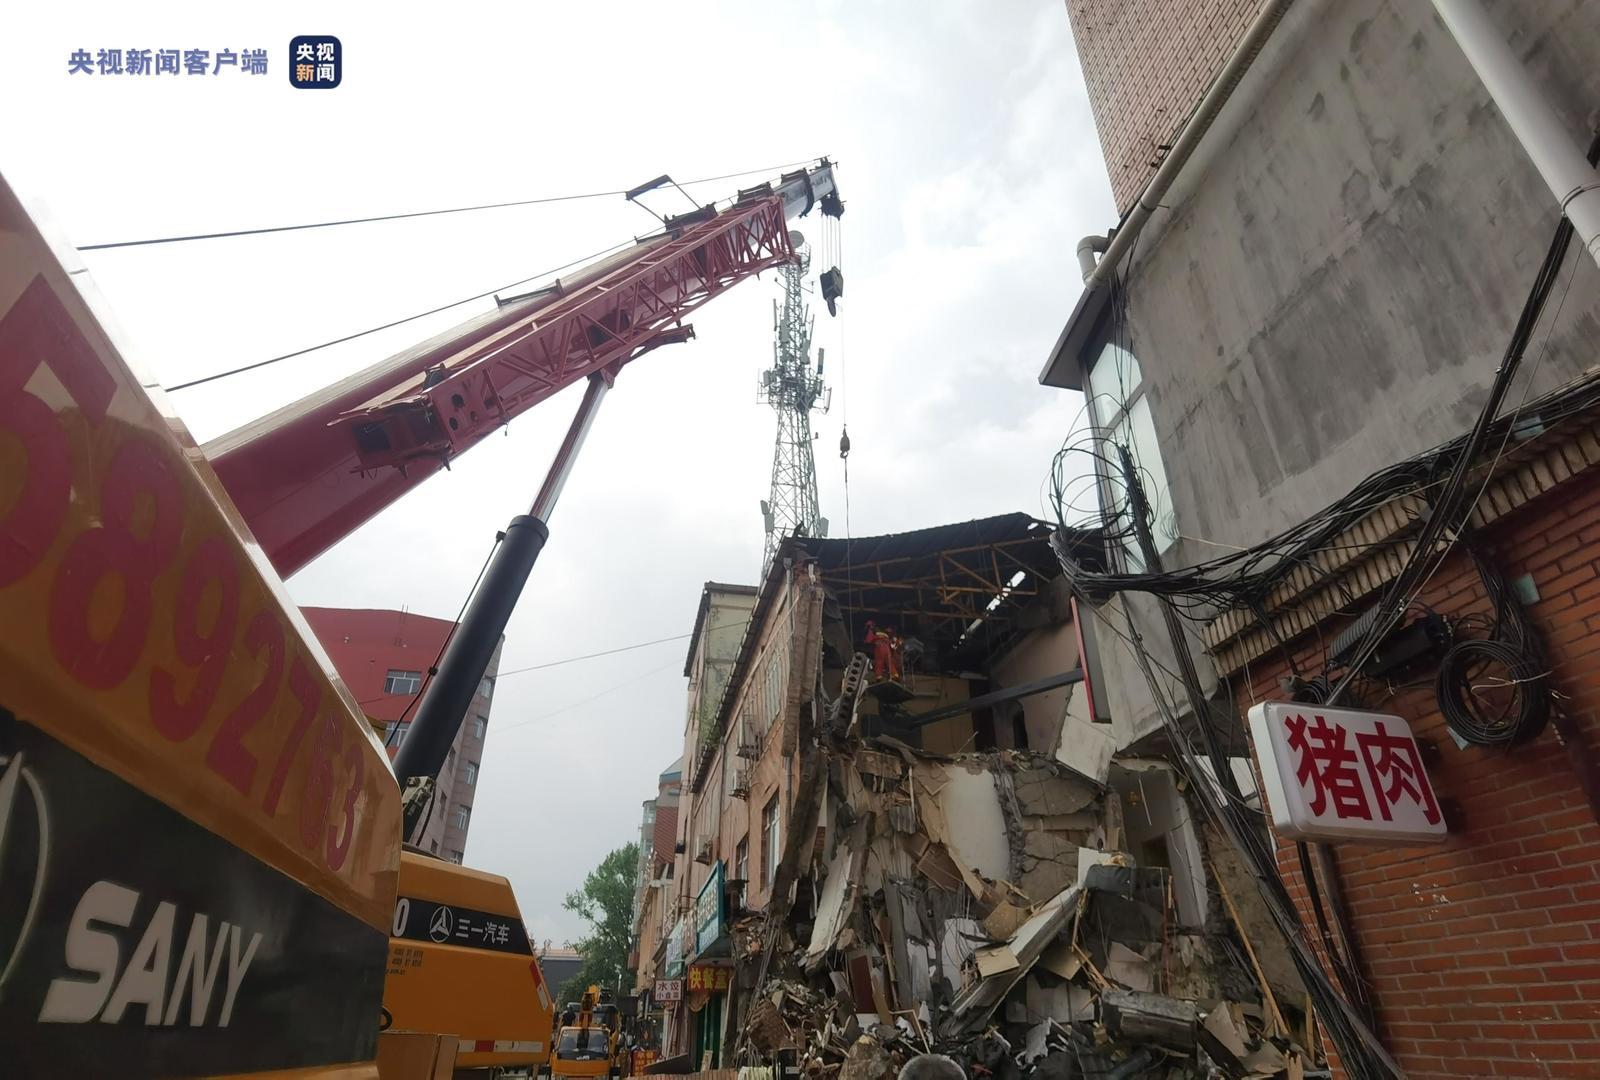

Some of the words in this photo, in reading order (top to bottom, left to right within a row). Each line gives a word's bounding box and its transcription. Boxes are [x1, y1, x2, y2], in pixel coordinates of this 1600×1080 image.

[1284, 713, 1441, 826] 猪肉
[37, 880, 263, 1028] SANY
[456, 918, 510, 944] 三一汽车
